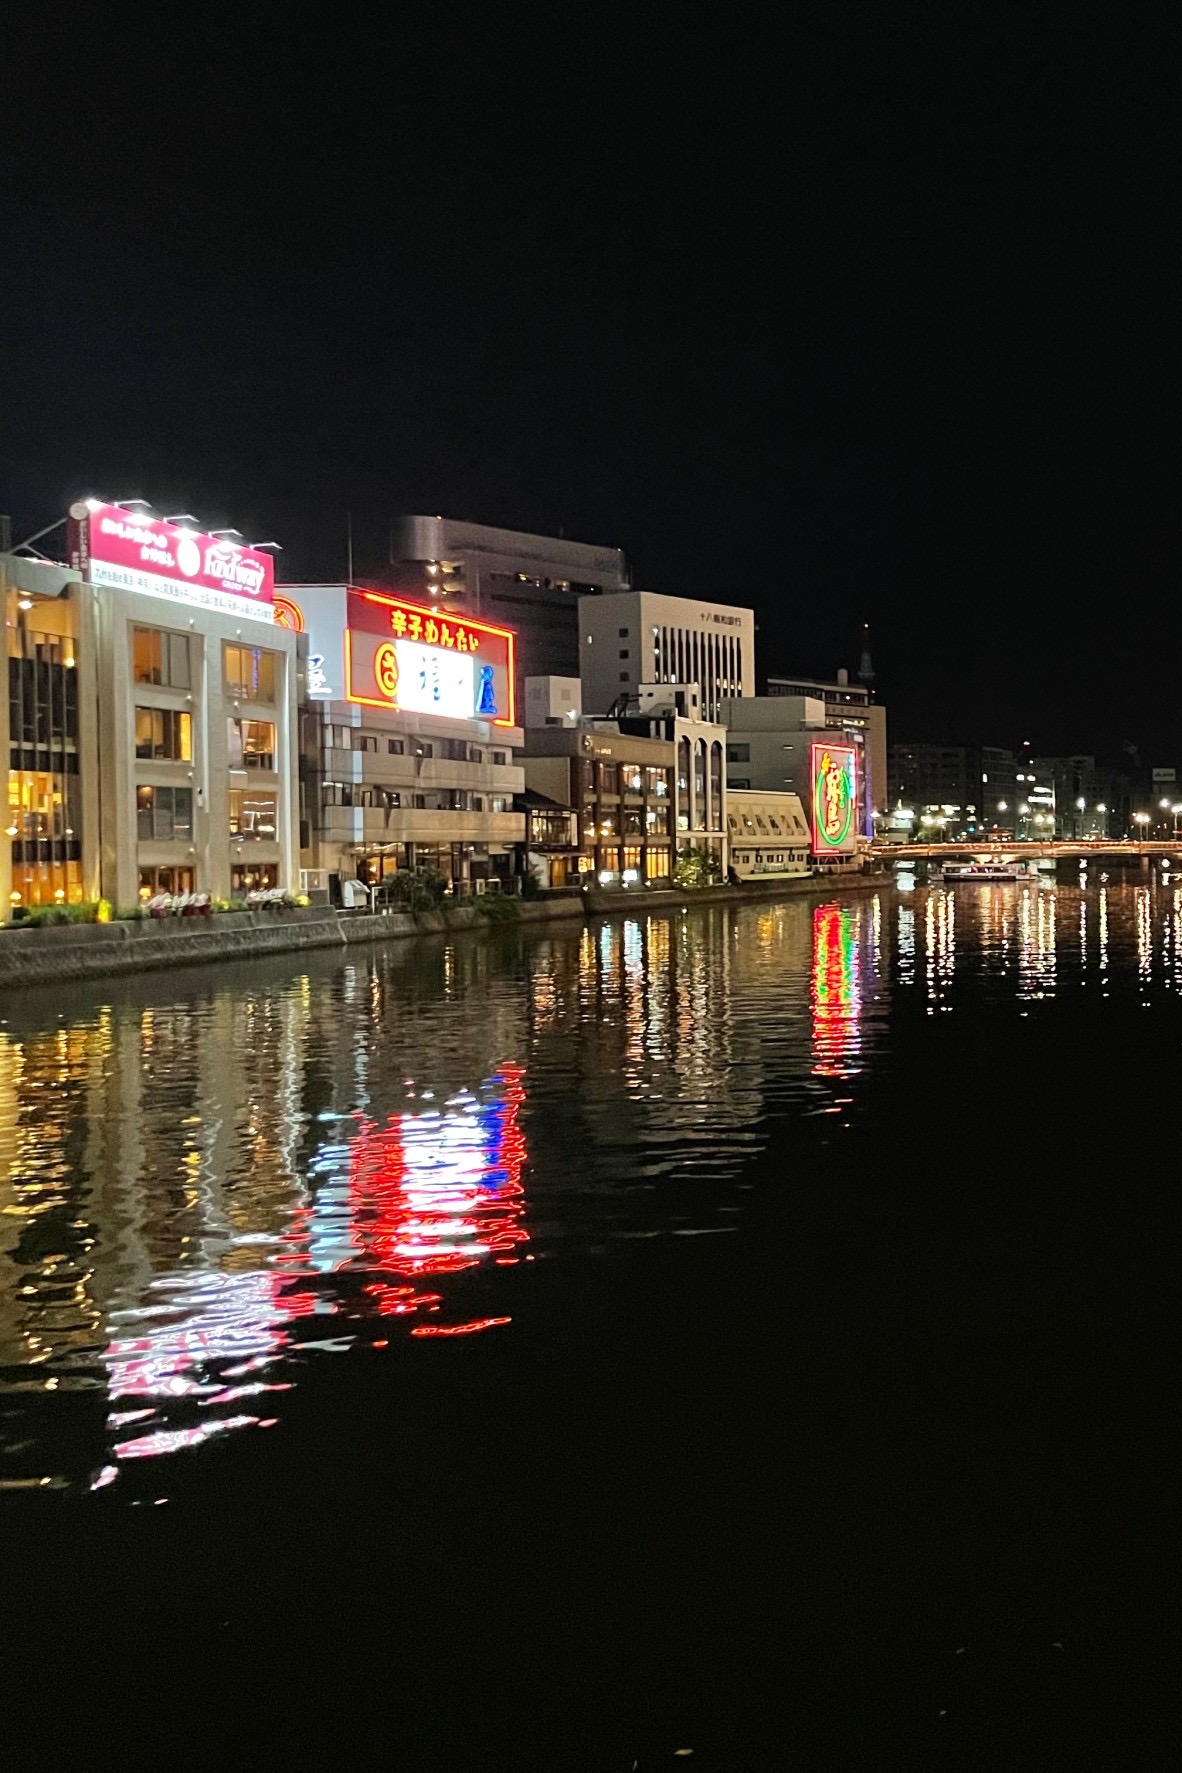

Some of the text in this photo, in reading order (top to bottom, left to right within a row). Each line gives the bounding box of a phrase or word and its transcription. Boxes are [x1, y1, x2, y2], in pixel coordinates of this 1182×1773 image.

[391, 609, 480, 652] 辛子めんたい
